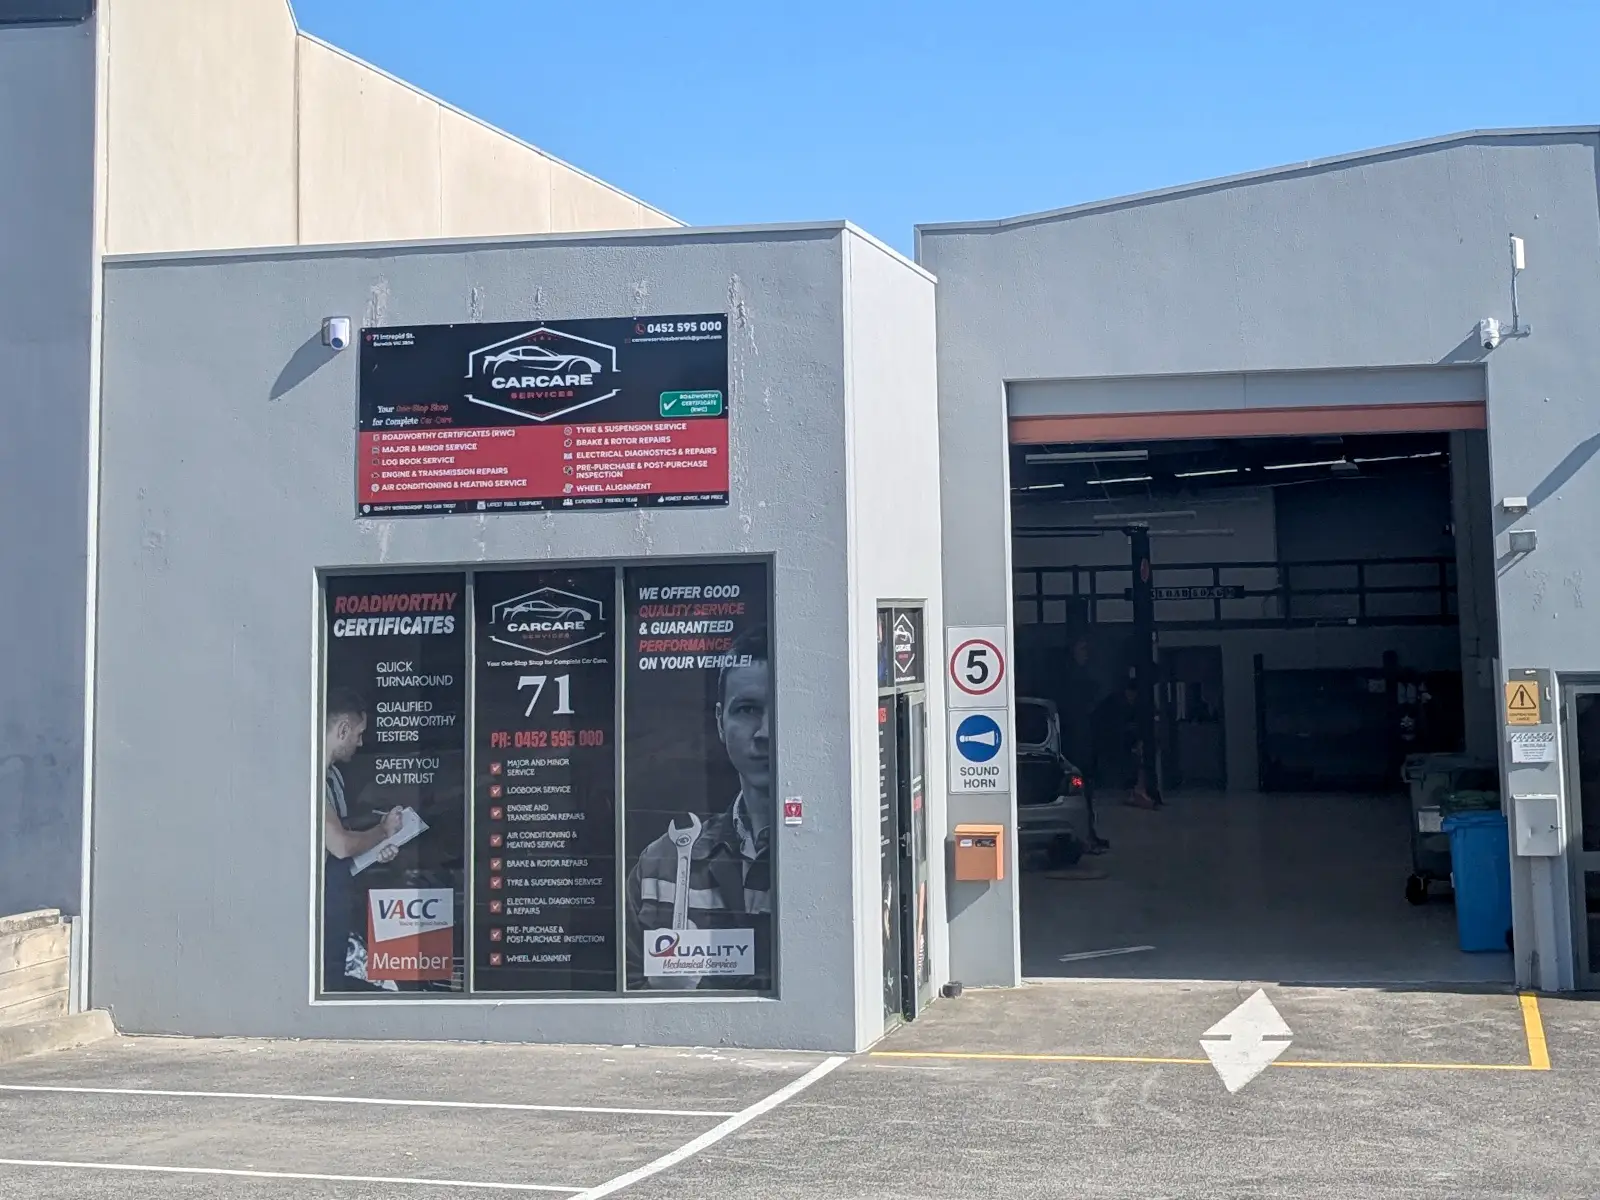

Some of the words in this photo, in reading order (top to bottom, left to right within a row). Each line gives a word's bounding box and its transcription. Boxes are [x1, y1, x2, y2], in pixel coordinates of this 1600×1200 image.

[648, 322, 674, 333] 0452
[678, 322, 697, 332] 595
[700, 321, 721, 331] 000
[491, 374, 593, 389] CARCARE
[510, 390, 574, 399] SERVICES
[430, 404, 448, 412] Shop
[373, 418, 383, 426] for
[385, 417, 418, 426] Complete
[605, 424, 653, 432] SUSPENSION
[382, 432, 436, 441] ROADWORTHY
[438, 431, 490, 439] CERTIFICATES
[576, 438, 602, 446] BRAKE
[611, 437, 637, 445] ROTOR
[446, 443, 477, 451] SERVICE
[577, 451, 623, 459] ELECTRICAL
[625, 449, 677, 457] DIAGNOSTICS
[577, 463, 635, 471] PRE-PURCHASE
[644, 460, 708, 469] POST-PURCHASE
[419, 468, 475, 477] TRANSMISSION
[477, 467, 508, 475] REPAIRS
[576, 471, 623, 479] INSPECTION
[396, 482, 451, 490] CONDITIONING
[606, 483, 651, 491] ALIGNMENT
[639, 588, 658, 599] WE
[661, 587, 700, 598] OFFER
[704, 585, 739, 598] GOOD
[335, 593, 457, 613] ROADWORTHY
[640, 604, 692, 618] QUALITY
[694, 603, 745, 616] SERVICE
[334, 616, 454, 637] CERTIFICATES
[507, 621, 585, 632] CARCARE
[639, 623, 647, 635] &
[651, 620, 733, 634] GUARANTEED
[639, 638, 731, 652] PERFORMANCE
[377, 662, 412, 673] QUICK
[639, 658, 656, 670] ON
[661, 657, 694, 669] YOUR
[698, 655, 752, 668] VEHICLE!
[966, 650, 988, 684] 5
[377, 675, 453, 686] TURNAROUND
[518, 674, 575, 717] 71
[377, 702, 432, 713] QUALIFIED
[377, 715, 456, 727] ROADWORTHY
[377, 730, 418, 741] TESTERS
[491, 732, 511, 748] PH:
[515, 732, 547, 747] 0452
[552, 731, 575, 746] 595
[579, 730, 603, 745] 000
[376, 759, 415, 769] SAFETY
[416, 758, 439, 768] YOU
[507, 760, 529, 768] MAJOR
[960, 767, 999, 776] SOUND
[376, 774, 400, 784] CAN
[403, 773, 434, 783] TRUST
[964, 779, 996, 788] HORN
[378, 899, 438, 919] VACC
[649, 932, 748, 957] QUALITY
[372, 952, 448, 969] Member
[663, 959, 704, 969] Mechanical
[706, 958, 737, 968] Services
